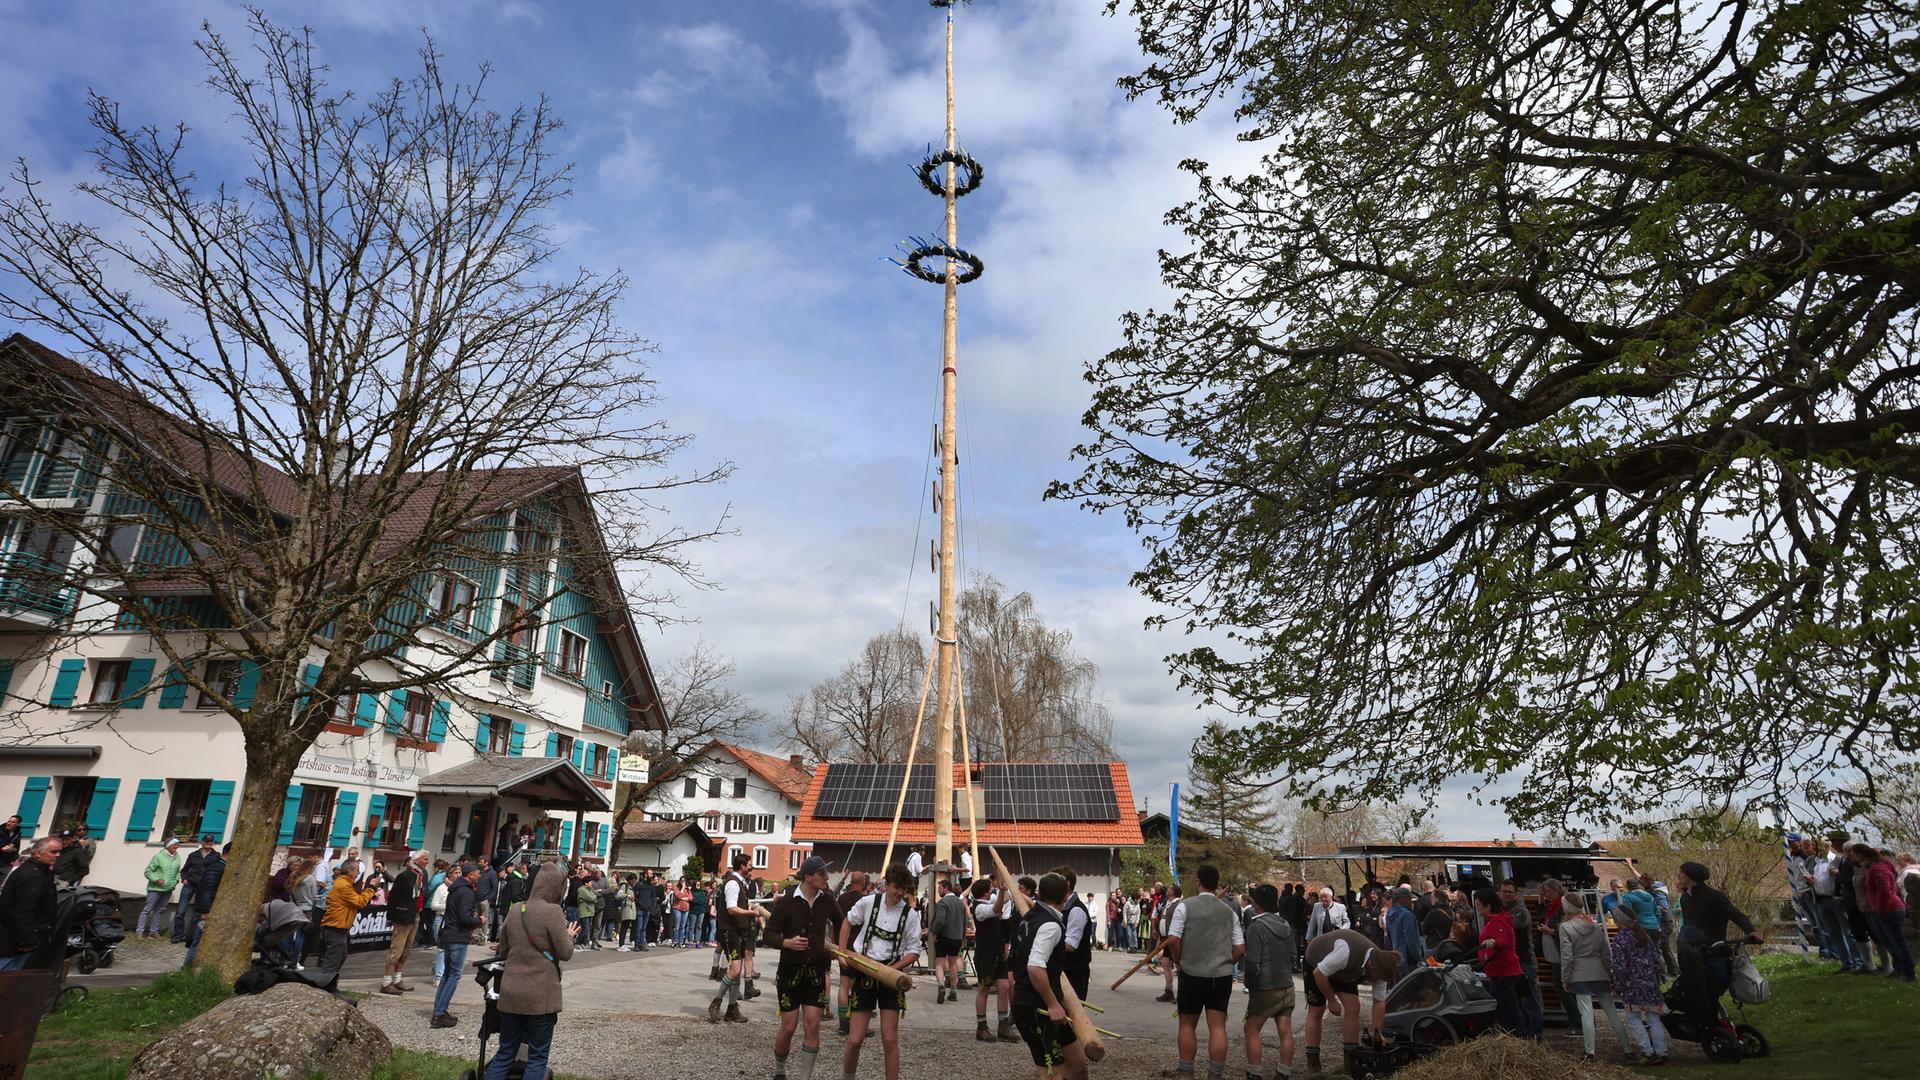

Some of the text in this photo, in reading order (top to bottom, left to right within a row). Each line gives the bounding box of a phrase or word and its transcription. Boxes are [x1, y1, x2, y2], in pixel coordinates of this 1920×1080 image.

[299, 757, 406, 783] irtshaus zum lustigen Hirsch
